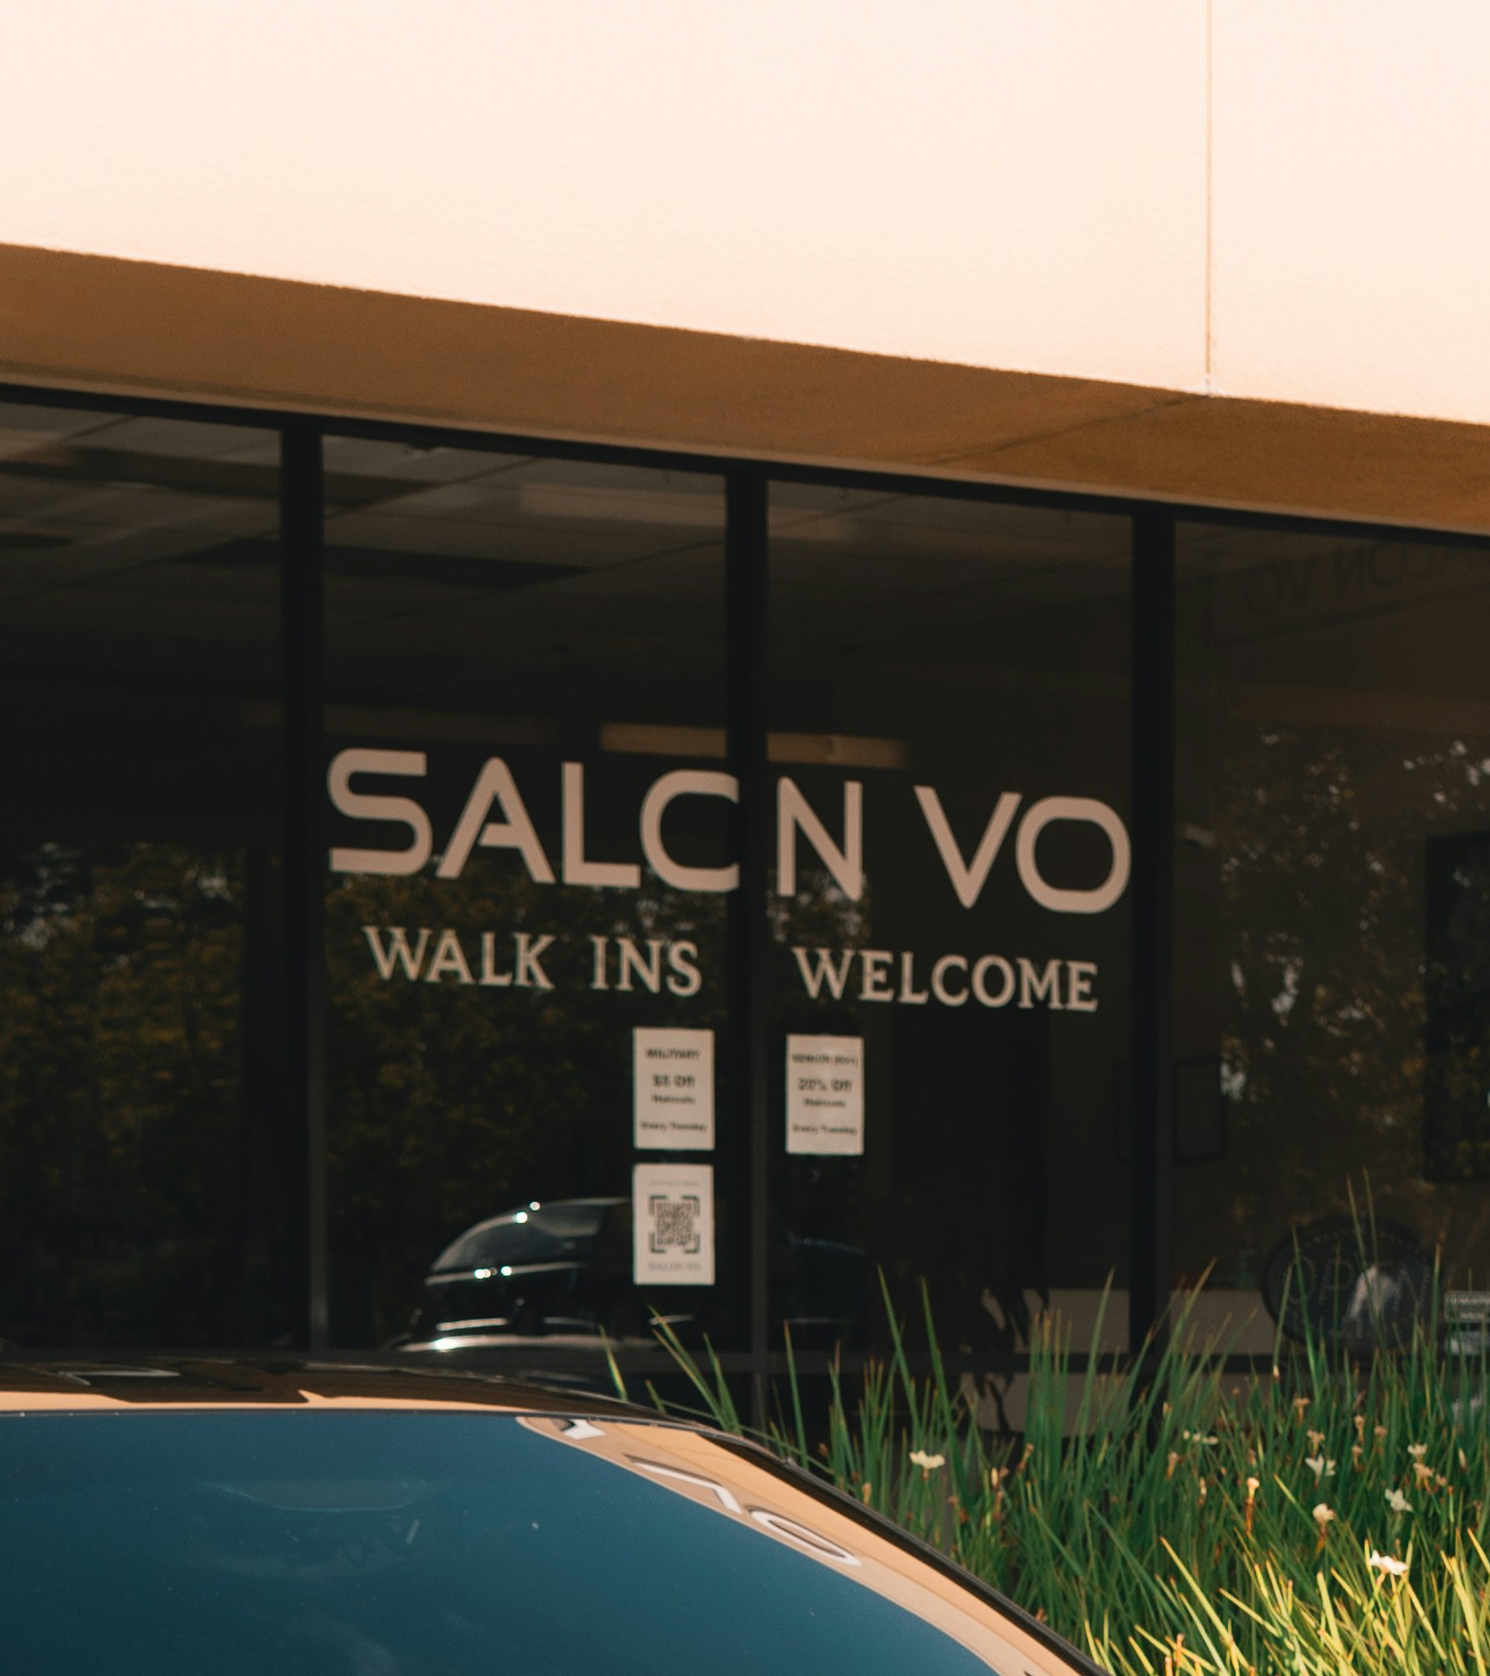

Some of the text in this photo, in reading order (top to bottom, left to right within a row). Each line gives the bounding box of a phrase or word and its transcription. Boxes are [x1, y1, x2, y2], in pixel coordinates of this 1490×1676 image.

[326, 747, 1132, 914] SALON VO
[362, 926, 1099, 1012] WALK INS WELCOME
